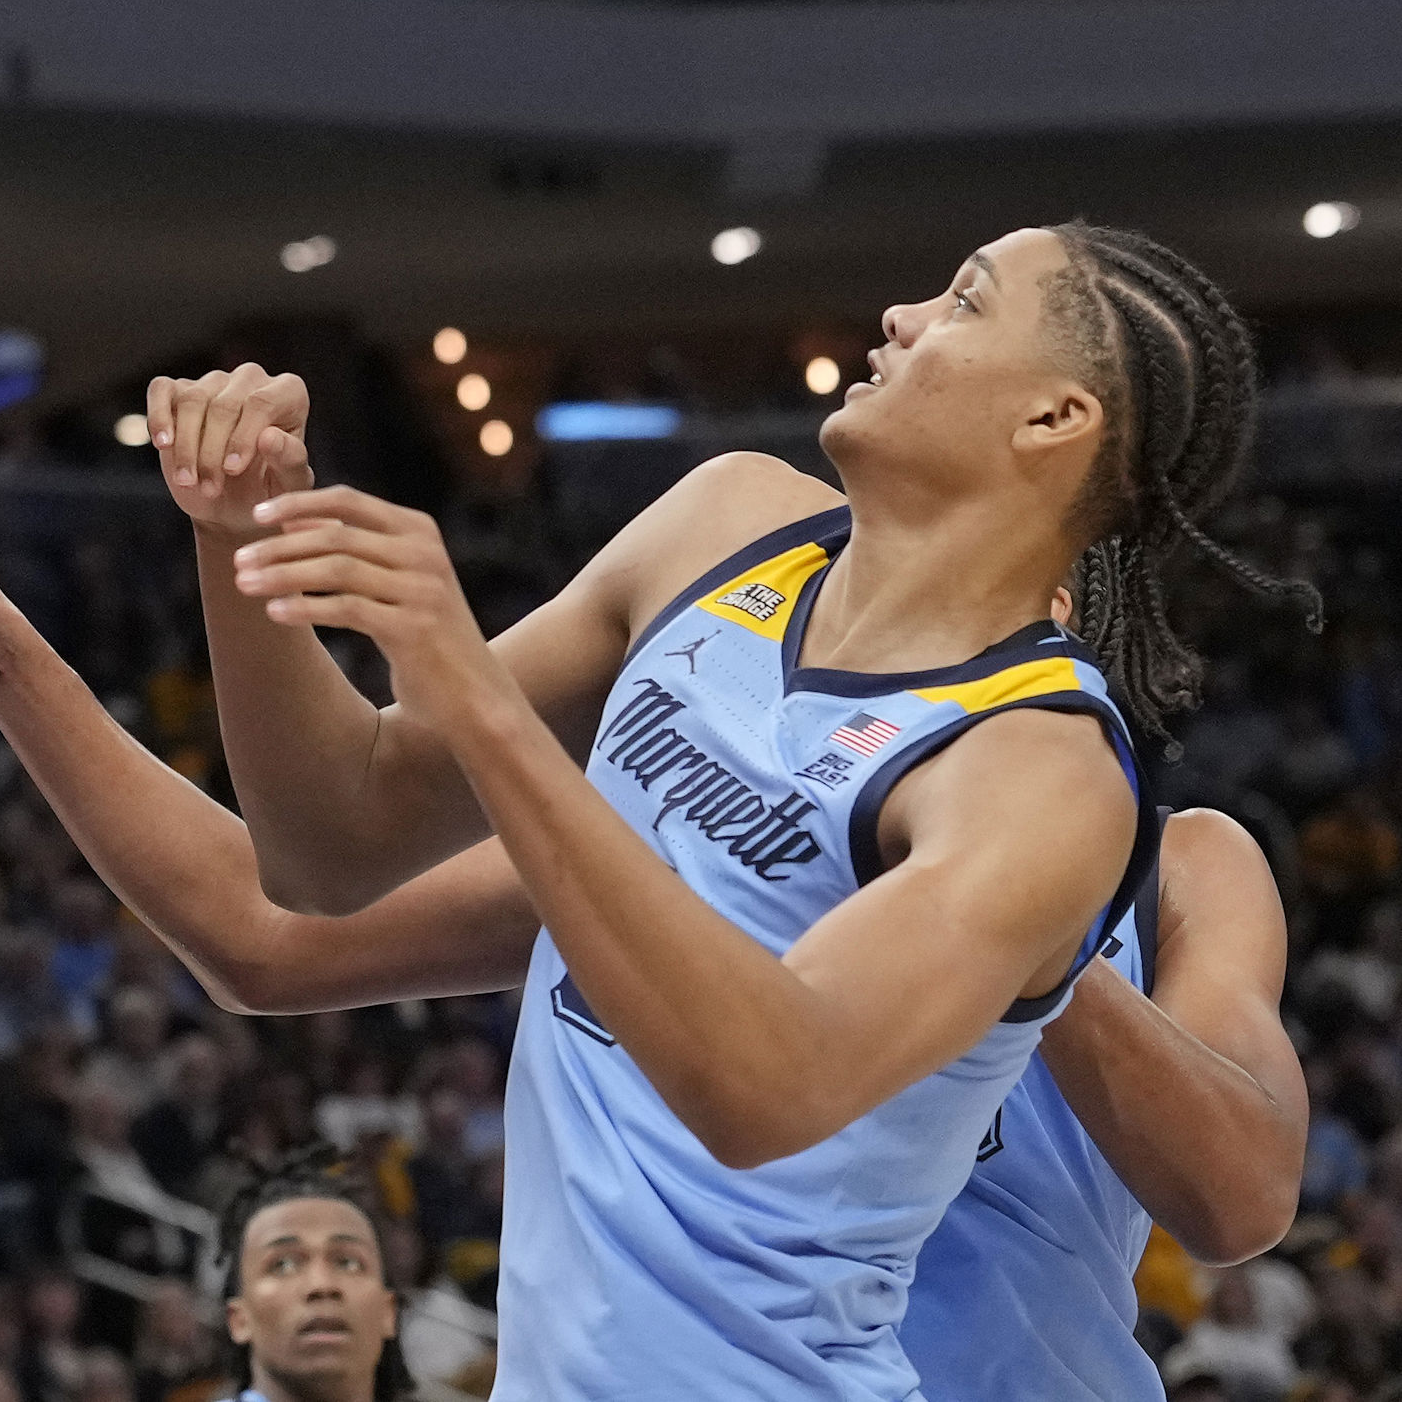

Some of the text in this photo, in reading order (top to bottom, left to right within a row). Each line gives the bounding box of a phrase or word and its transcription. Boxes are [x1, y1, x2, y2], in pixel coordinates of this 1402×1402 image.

[749, 583, 786, 609] THE
[803, 762, 850, 786] EAST
[817, 752, 854, 771] BIG
[597, 678, 822, 882] Marquette
